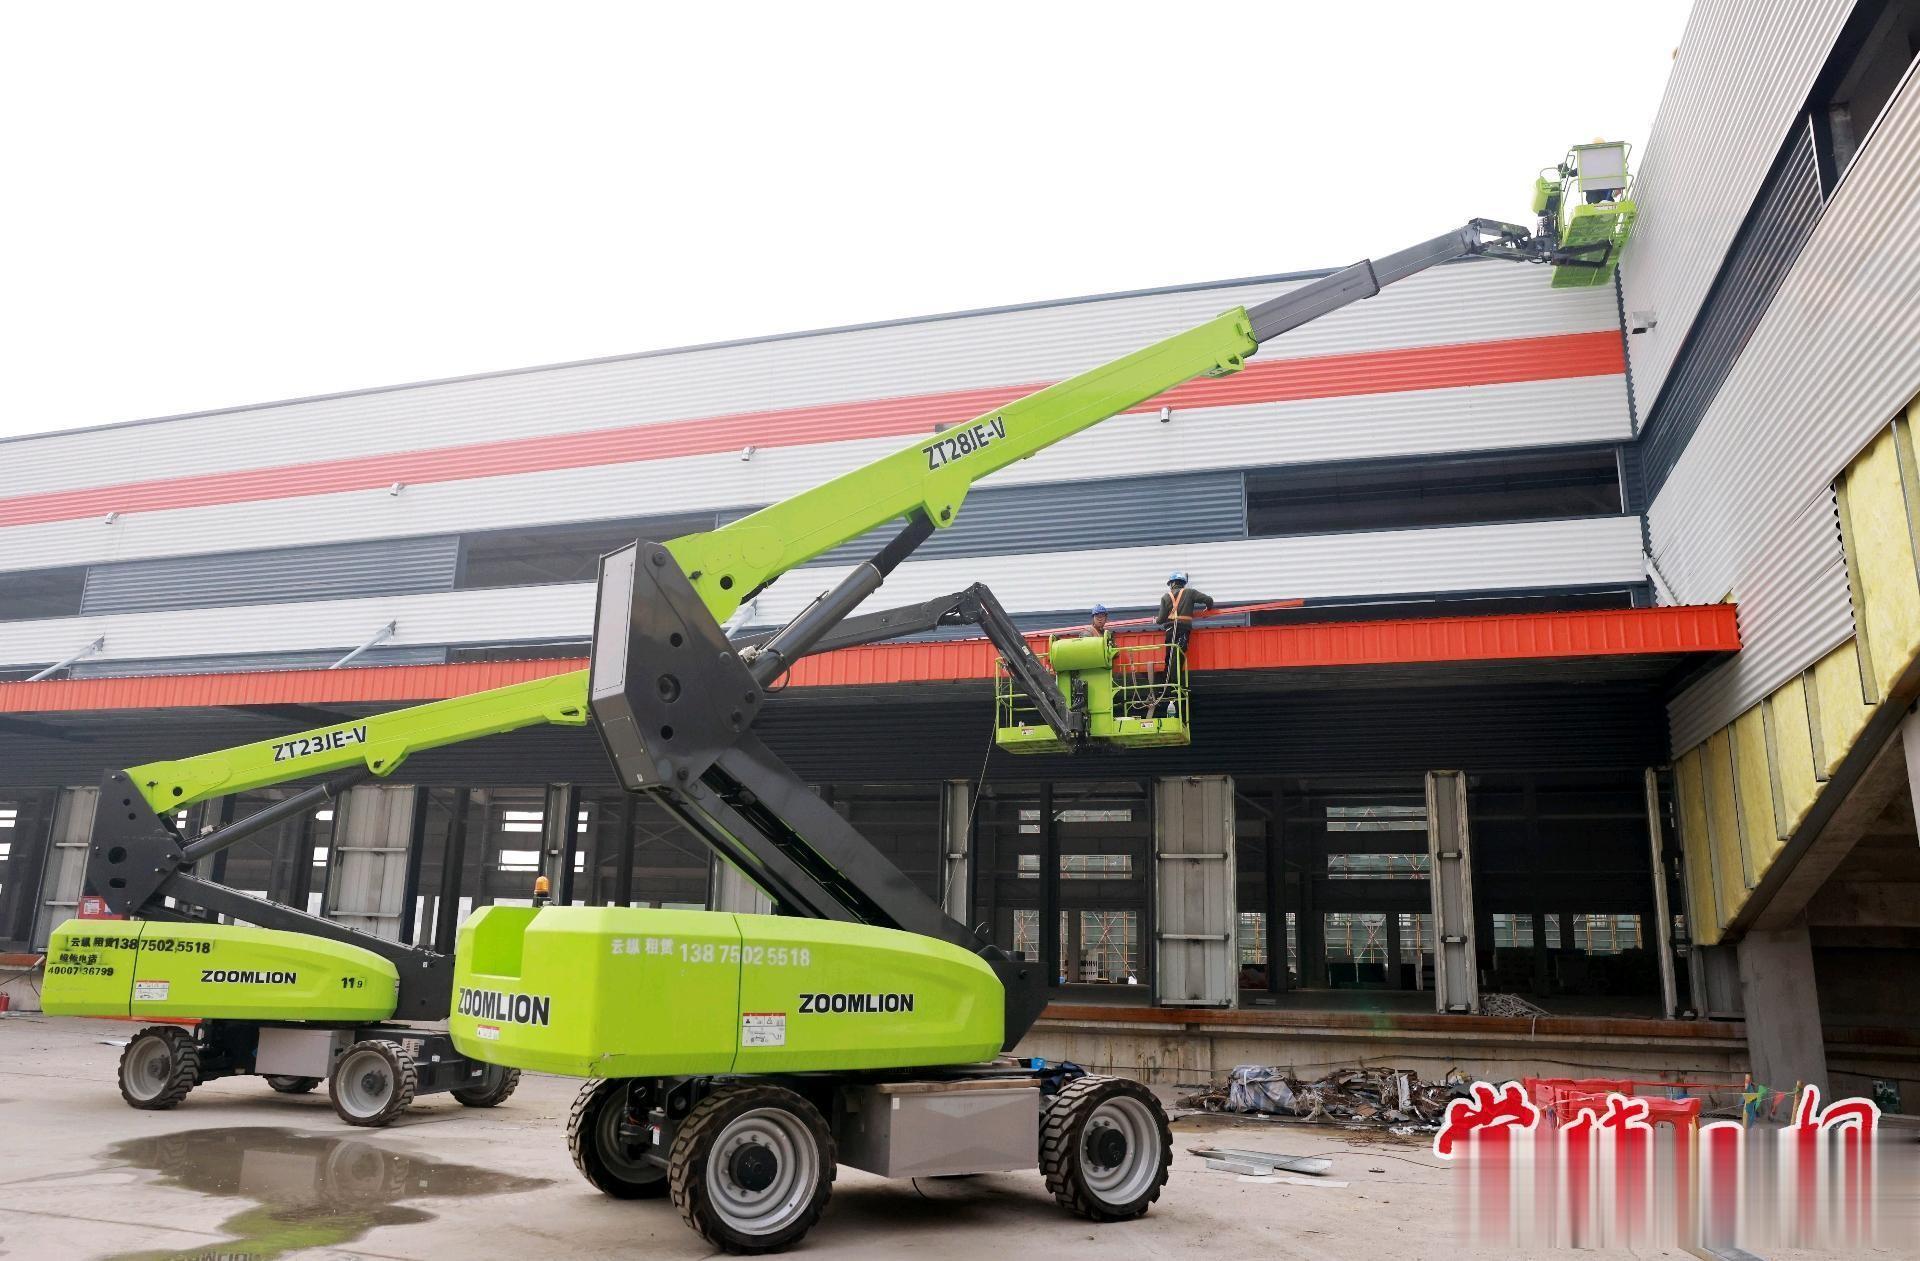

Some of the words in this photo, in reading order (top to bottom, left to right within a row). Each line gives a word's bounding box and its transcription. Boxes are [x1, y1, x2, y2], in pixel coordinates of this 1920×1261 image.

[922, 416, 1006, 470] ZT28JE-V
[272, 725, 367, 762] ZT23JE-V
[201, 970, 297, 984] ZOOMLION
[457, 987, 550, 1026] ZOOMLION
[798, 993, 914, 1013] ZOOMLION
